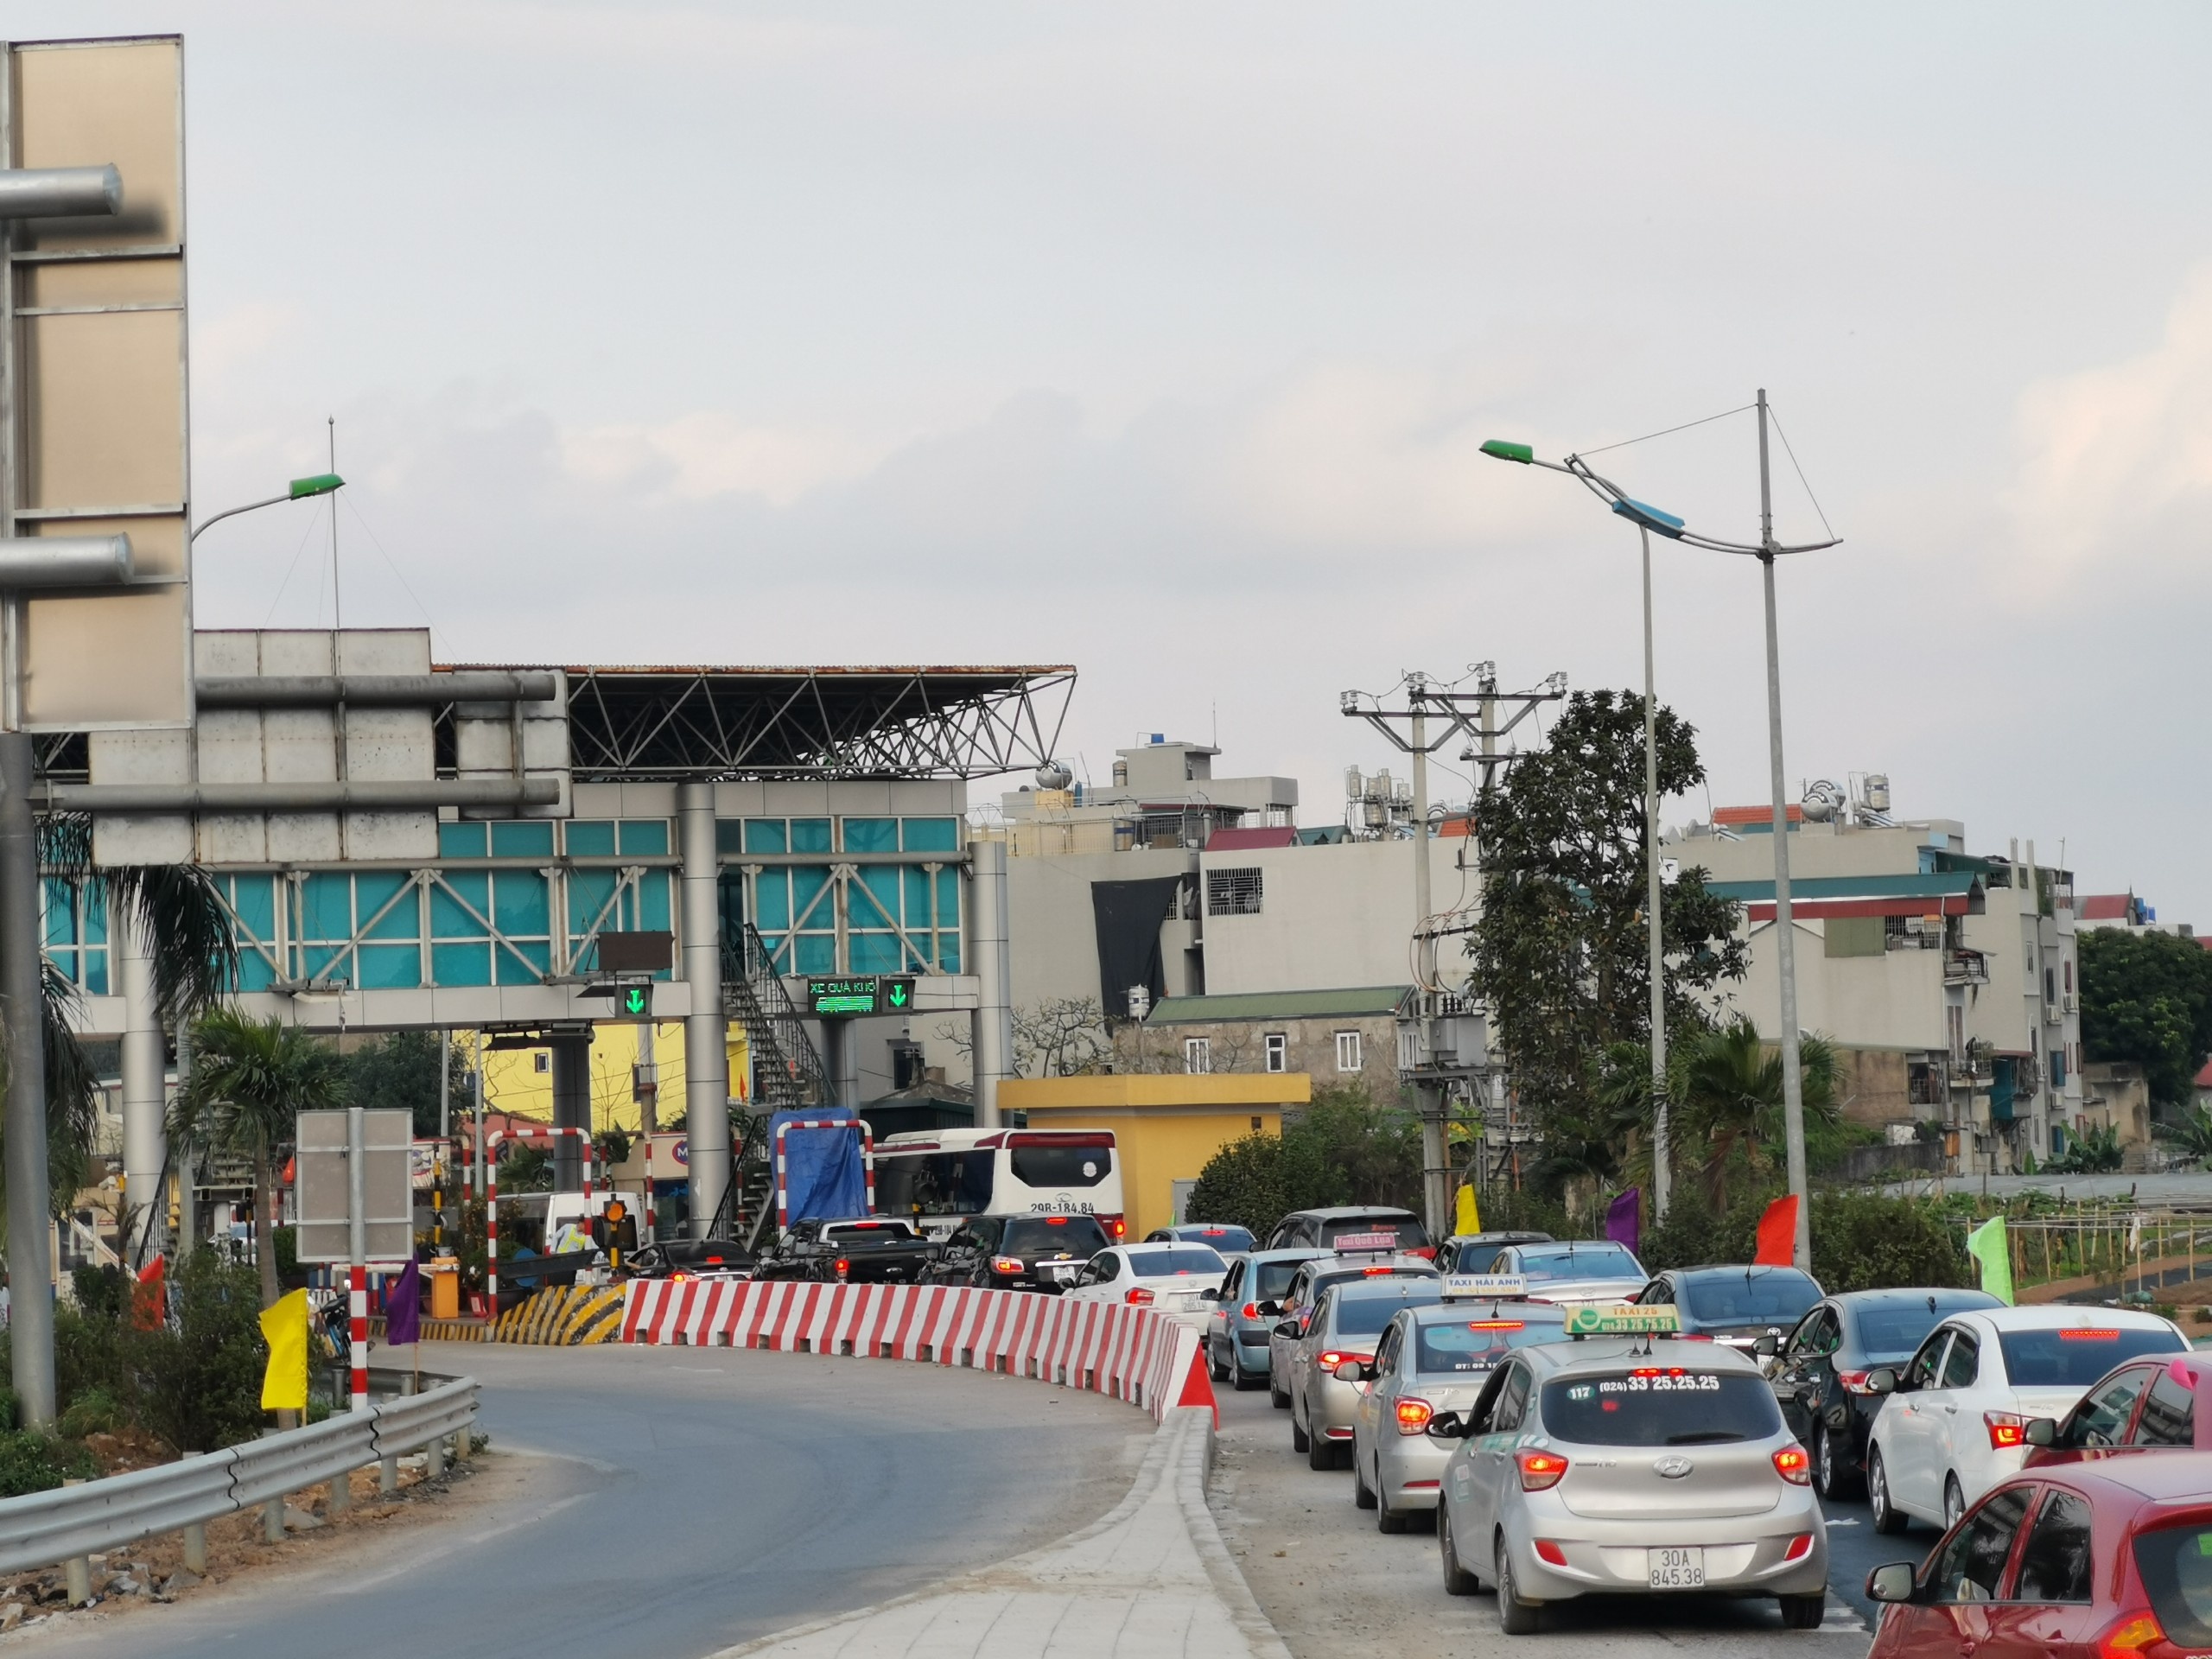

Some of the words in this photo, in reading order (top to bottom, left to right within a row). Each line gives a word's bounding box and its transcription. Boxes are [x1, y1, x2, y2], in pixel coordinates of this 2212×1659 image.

[1599, 1382, 1628, 1393] (024)
[1628, 1376, 1649, 1391] 33
[1652, 1375, 1720, 1390] 25.25.25
[1569, 1387, 1591, 1400] 117
[1661, 1550, 1690, 1567] 30A
[1651, 1567, 1703, 1586] 845.38
